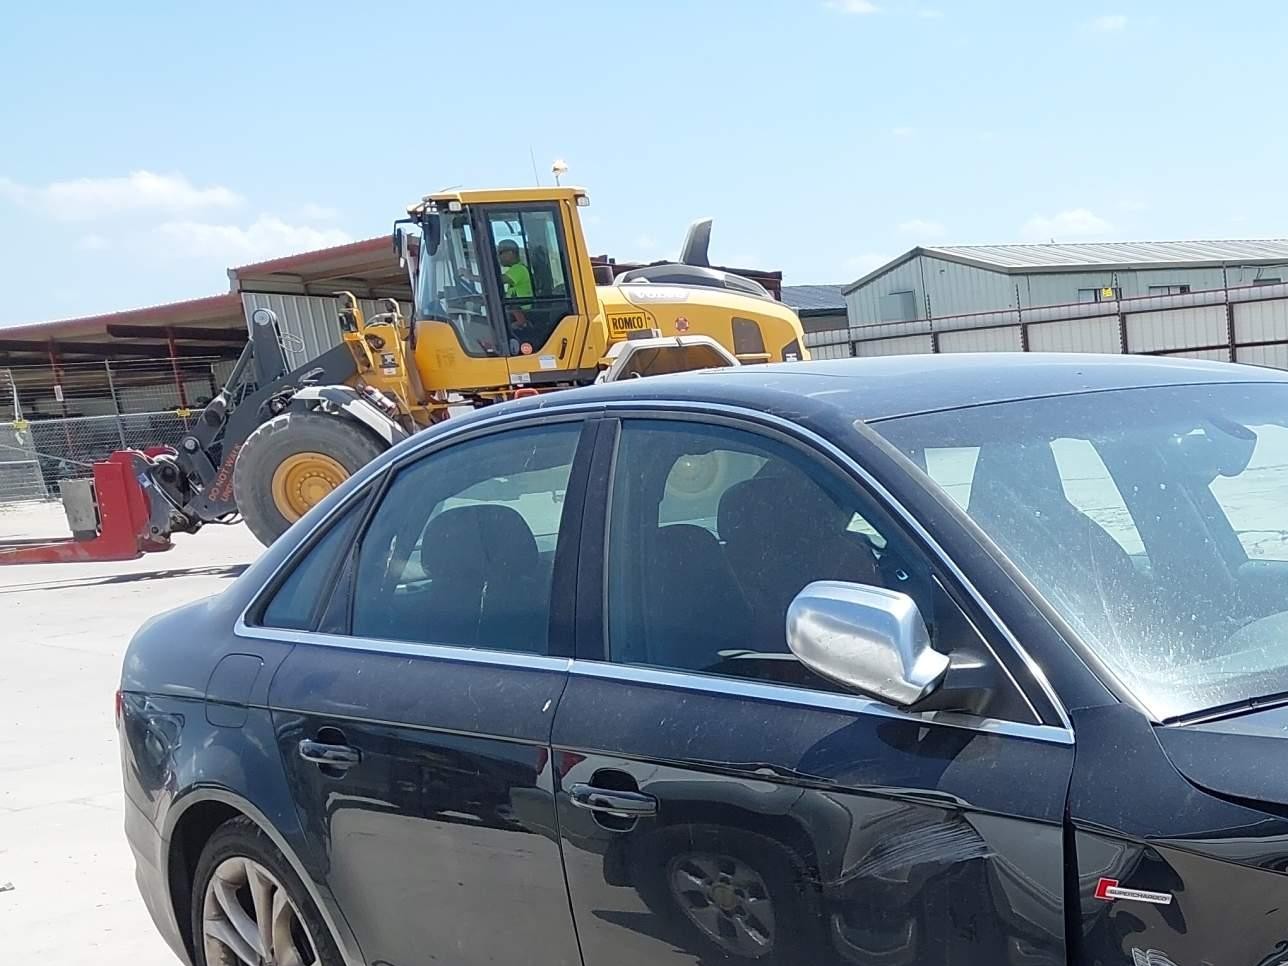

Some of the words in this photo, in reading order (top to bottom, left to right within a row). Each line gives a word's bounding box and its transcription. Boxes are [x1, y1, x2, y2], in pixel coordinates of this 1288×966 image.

[611, 317, 643, 330] ROMCO
[208, 487, 220, 501] DO
[215, 467, 230, 487] NOT
